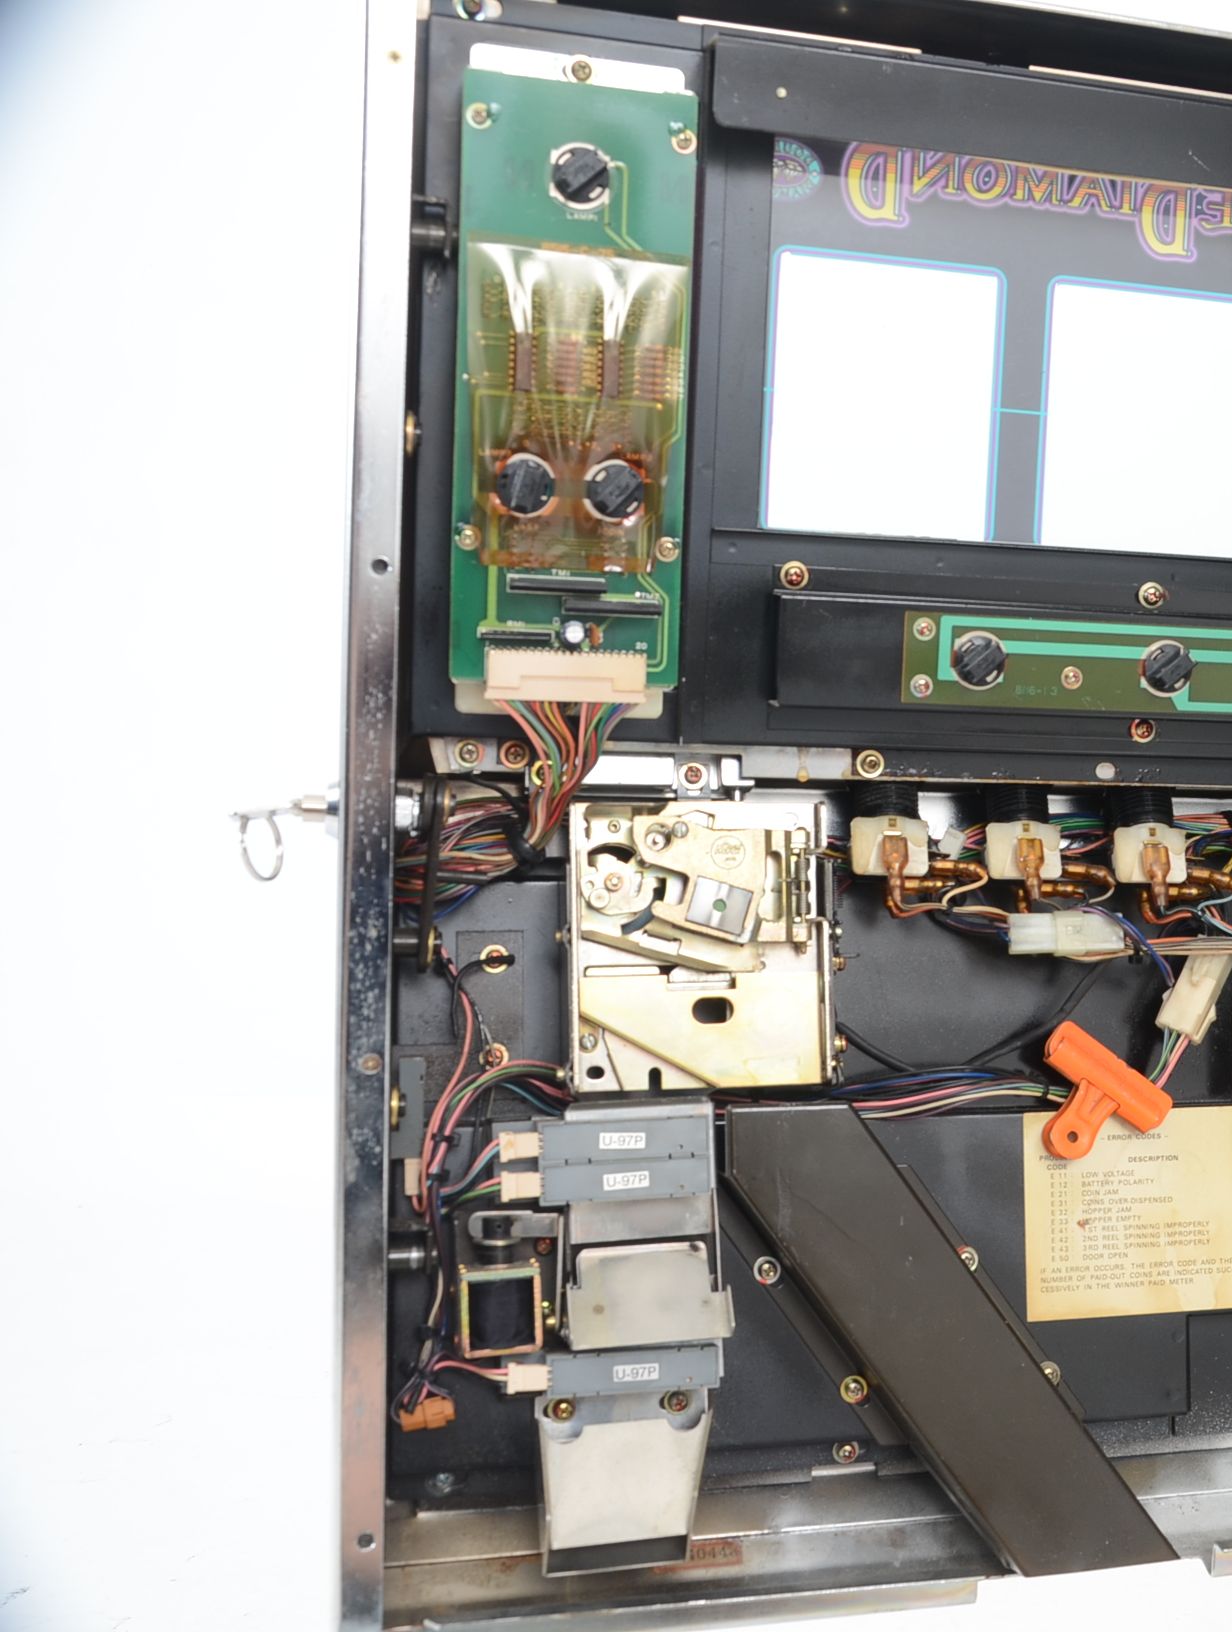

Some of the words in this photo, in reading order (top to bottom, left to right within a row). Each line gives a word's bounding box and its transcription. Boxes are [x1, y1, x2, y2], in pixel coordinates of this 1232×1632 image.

[602, 1135, 643, 1147] U-97P
[1128, 1154, 1179, 1163] DESCRIPTION
[1103, 1170, 1135, 1178] VOLTAGE
[606, 1174, 647, 1188] U-97P
[1081, 1180, 1114, 1188] BATTERY
[1118, 1178, 1154, 1186] POLARITY
[1082, 1207, 1112, 1215] HOPPER
[1116, 1214, 1142, 1222] EMPTY
[1123, 1223, 1160, 1231] SPINNING
[1164, 1220, 1210, 1229] IMPROPERLY
[1124, 1232, 1161, 1240] SPINNING
[1164, 1230, 1210, 1238] IMPROPERLY
[1124, 1241, 1161, 1249] SPINNING
[1164, 1239, 1211, 1247] IMPROPERLY
[1082, 1253, 1104, 1261] DOOR
[1065, 1265, 1090, 1273] ERROR
[1149, 1260, 1174, 1268] ERROR
[1177, 1259, 1197, 1267] CODE
[1200, 1258, 1216, 1266] AND
[1040, 1275, 1073, 1284] NUMBER
[1129, 1271, 1153, 1279] COINS
[1174, 1268, 1213, 1277] INDICATED
[1040, 1285, 1080, 1293] CESSIVELY
[1114, 1280, 1145, 1288] WINNER
[1148, 1279, 1166, 1287] PAID
[616, 1366, 657, 1380] U-97P
